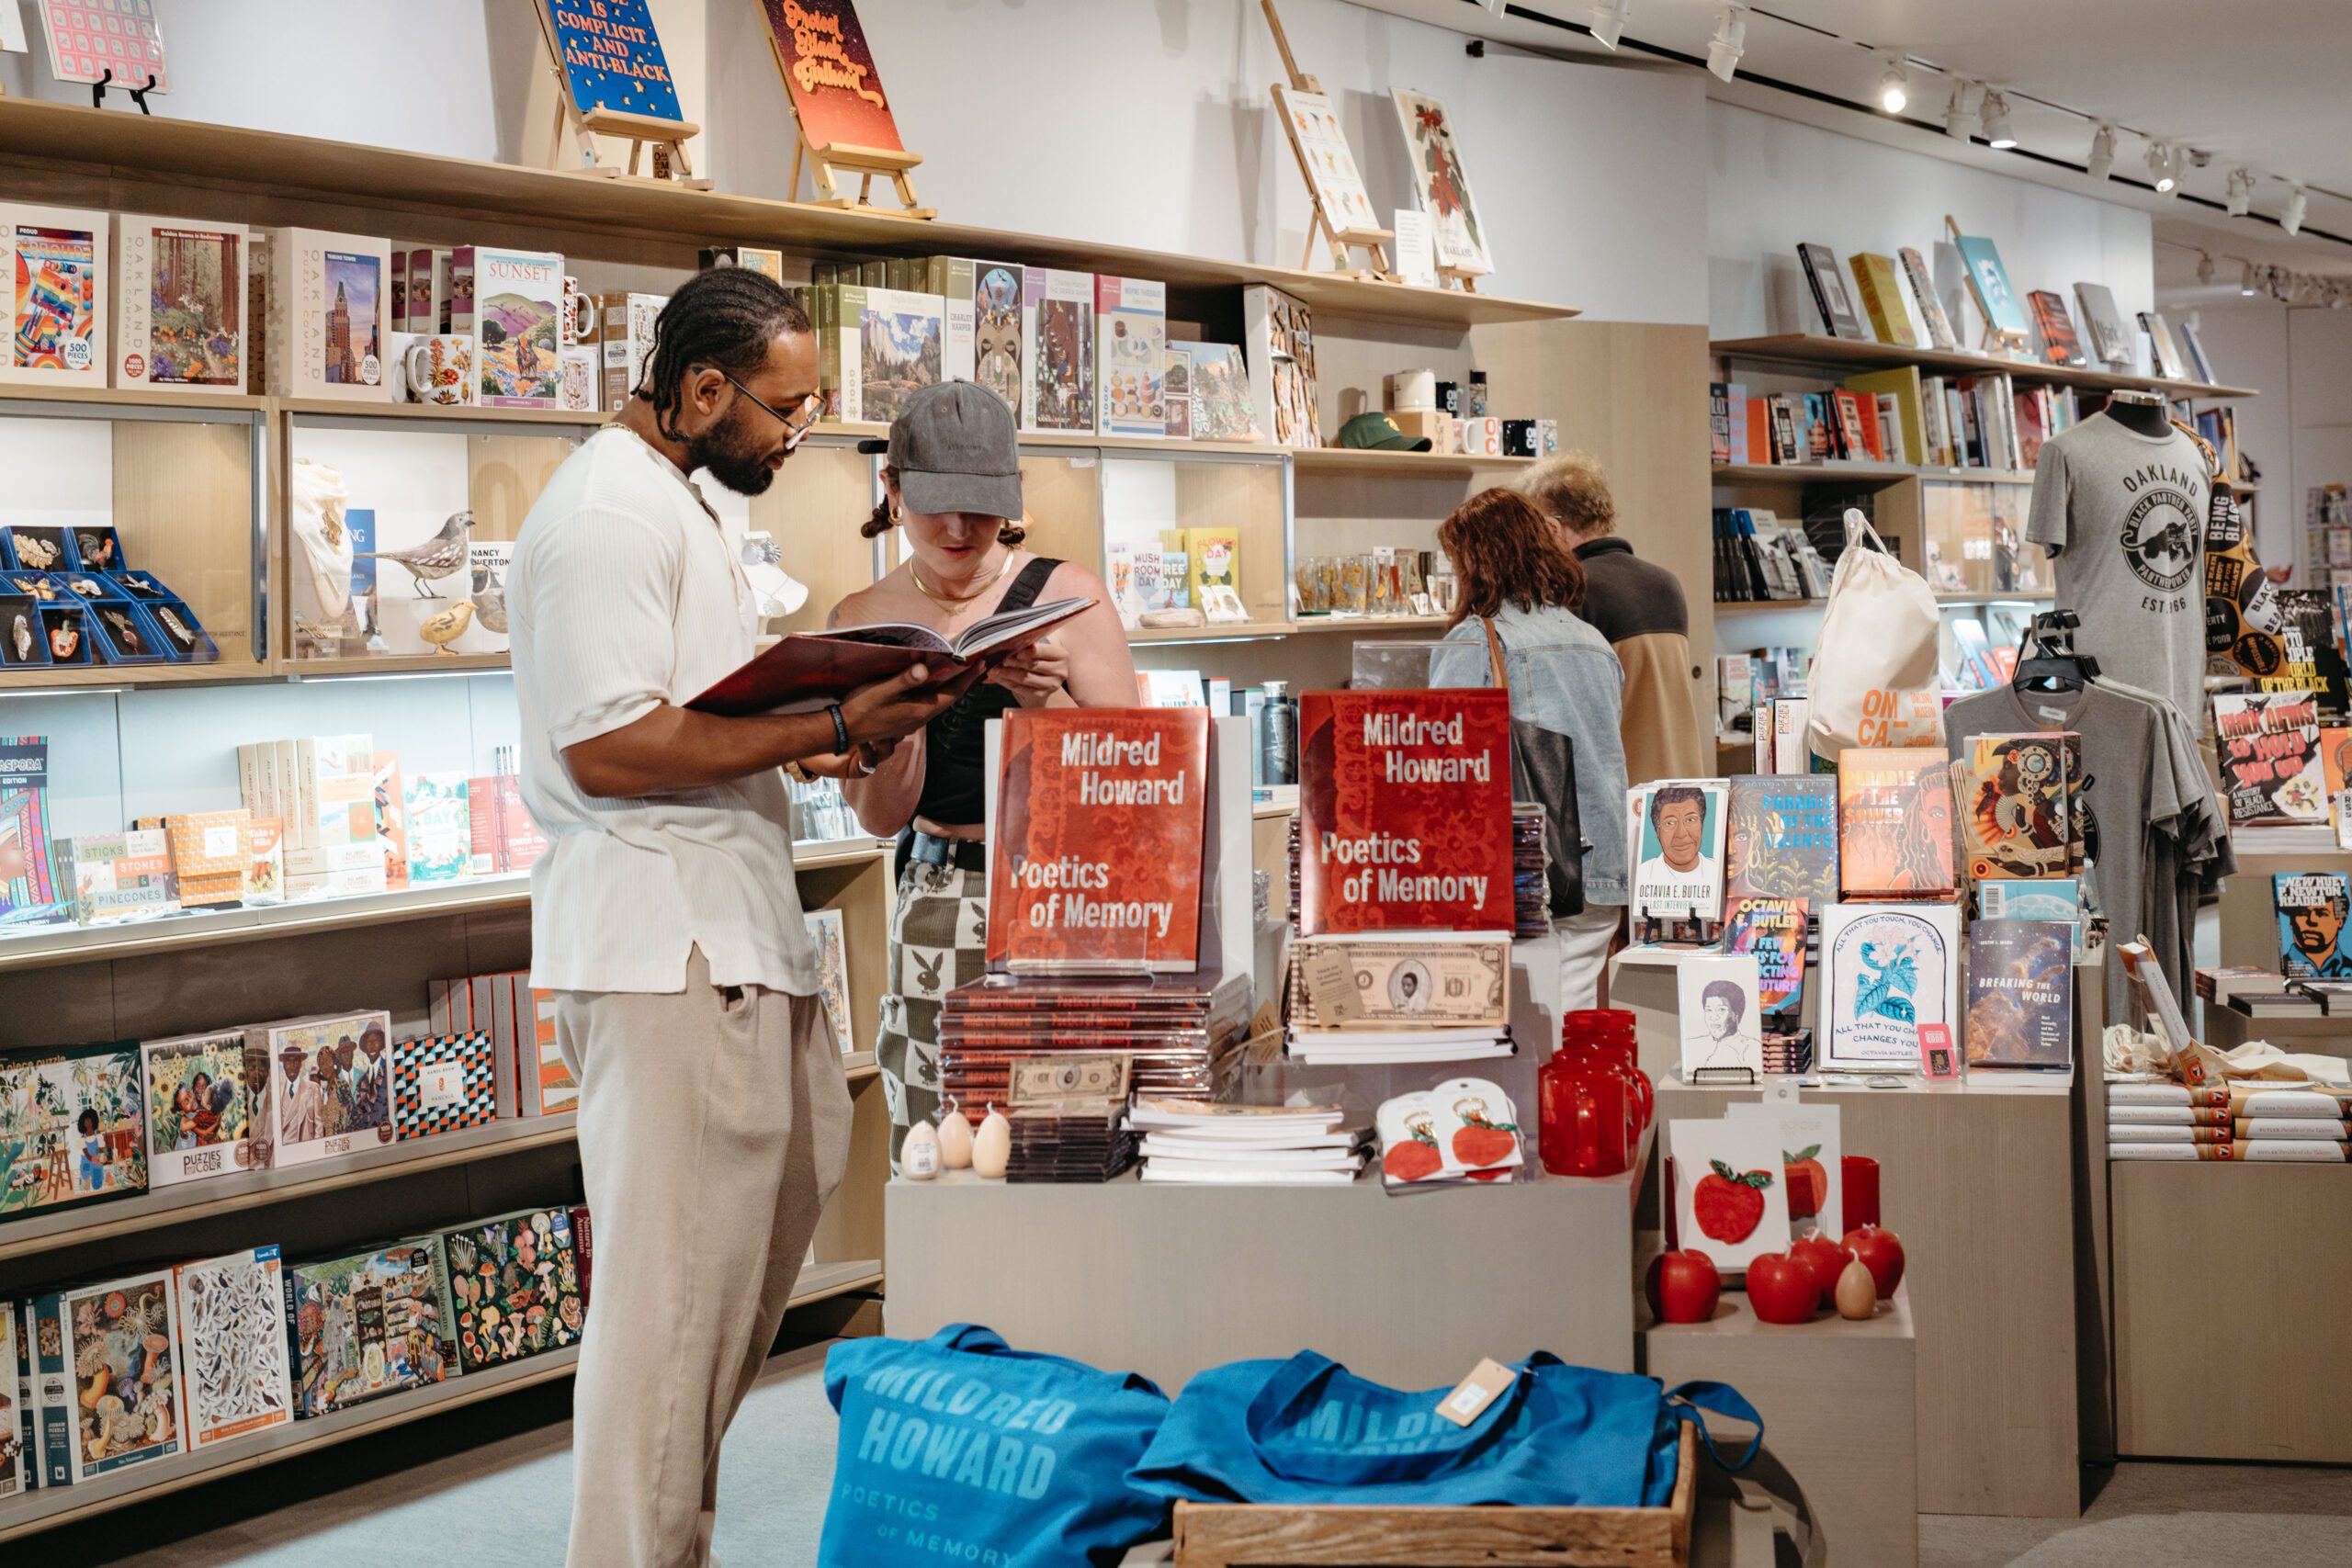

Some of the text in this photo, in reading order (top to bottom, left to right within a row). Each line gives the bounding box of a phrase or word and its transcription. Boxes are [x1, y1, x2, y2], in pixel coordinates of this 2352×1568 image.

[557, 10, 647, 44] COMPLICIT
[783, 0, 844, 42] Protect
[593, 36, 629, 58] AND
[565, 47, 671, 83] ANTI-BLACK
[793, 56, 884, 108] Girlhood
[488, 262, 553, 282] SUNSET
[133, 236, 144, 349] OAKLAND
[311, 249, 322, 380] OAKLAND
[950, 313, 973, 322] CHARLEY
[951, 322, 972, 333] HARPER
[67, 351, 89, 360] PIECES
[69, 343, 87, 352] 500
[363, 367, 379, 376] PIECES
[365, 360, 378, 368] 500
[2123, 464, 2199, 497] OAKLAND
[2128, 491, 2199, 536] BLACK PANTHER PARTY
[2209, 496, 2230, 541] BEING
[1198, 538, 1237, 549] FLOWER
[470, 549, 500, 558] NANCY
[1134, 553, 1160, 564] MUSH
[1205, 548, 1229, 559] DAY
[1134, 566, 1160, 577] ROOM
[1138, 577, 1157, 587] DAY
[2260, 676, 2330, 693] OF THE BLACK
[1861, 689, 1897, 719] OM
[1363, 712, 1464, 747] Mildred
[1060, 731, 1161, 768] Mildred
[2253, 731, 2307, 761] HOLD
[1385, 749, 1491, 784] Howard
[1844, 770, 1916, 787] PARABLE
[1080, 771, 1185, 807] Howard
[1845, 788, 1900, 806] OF THE
[1762, 795, 1835, 812] PARABLE
[2233, 801, 2274, 819] RESISTANCE
[1780, 813, 1835, 830] OF THE
[1844, 807, 1905, 824] SOWER
[250, 828, 269, 838] Take
[253, 837, 273, 847] Hike
[1320, 830, 1421, 865] Poetics
[85, 845, 125, 859] STICKS
[119, 860, 164, 874] STONES
[1010, 853, 1110, 889] Poetics
[1342, 868, 1489, 911] of Memory
[2286, 875, 2346, 888] NEW HUEY
[97, 889, 162, 905] PINECONES
[1639, 884, 1712, 898] OCTAVIA E. BUTLER
[2278, 886, 2342, 897] P. NEWTON
[1649, 899, 1664, 910] LAST
[1664, 900, 1693, 911] INTERVIEW
[1739, 898, 1799, 913] OCTAVIA
[2278, 895, 2327, 908] READER
[1029, 893, 1174, 939] of Memory
[1736, 913, 1800, 929] E. BUTLER
[1746, 937, 1784, 951] A FEW
[1836, 915, 1943, 956] ALL THAT YOU TOUCH, YOU CHANGE
[1770, 952, 1797, 965] FOR
[1978, 977, 2052, 991] BREAKING THE
[2021, 991, 2062, 1004] WORLD
[1835, 1021, 1903, 1035] ALL THAT YOU
[1852, 1034, 1898, 1046] CHANGES
[1900, 1037, 1919, 1049] YOU
[36, 1054, 67, 1066] puzzle
[184, 1149, 221, 1175] PUZZLES
[576, 1216, 585, 1254] Autumn
[582, 1216, 592, 1258] Nature in
[284, 1278, 296, 1325] WORLD OF
[863, 1363, 1078, 1437] MILDRED
[857, 1407, 1057, 1502] HOWARD
[841, 1483, 940, 1522] POETICS
[876, 1523, 1015, 1568] OF MEMORY
